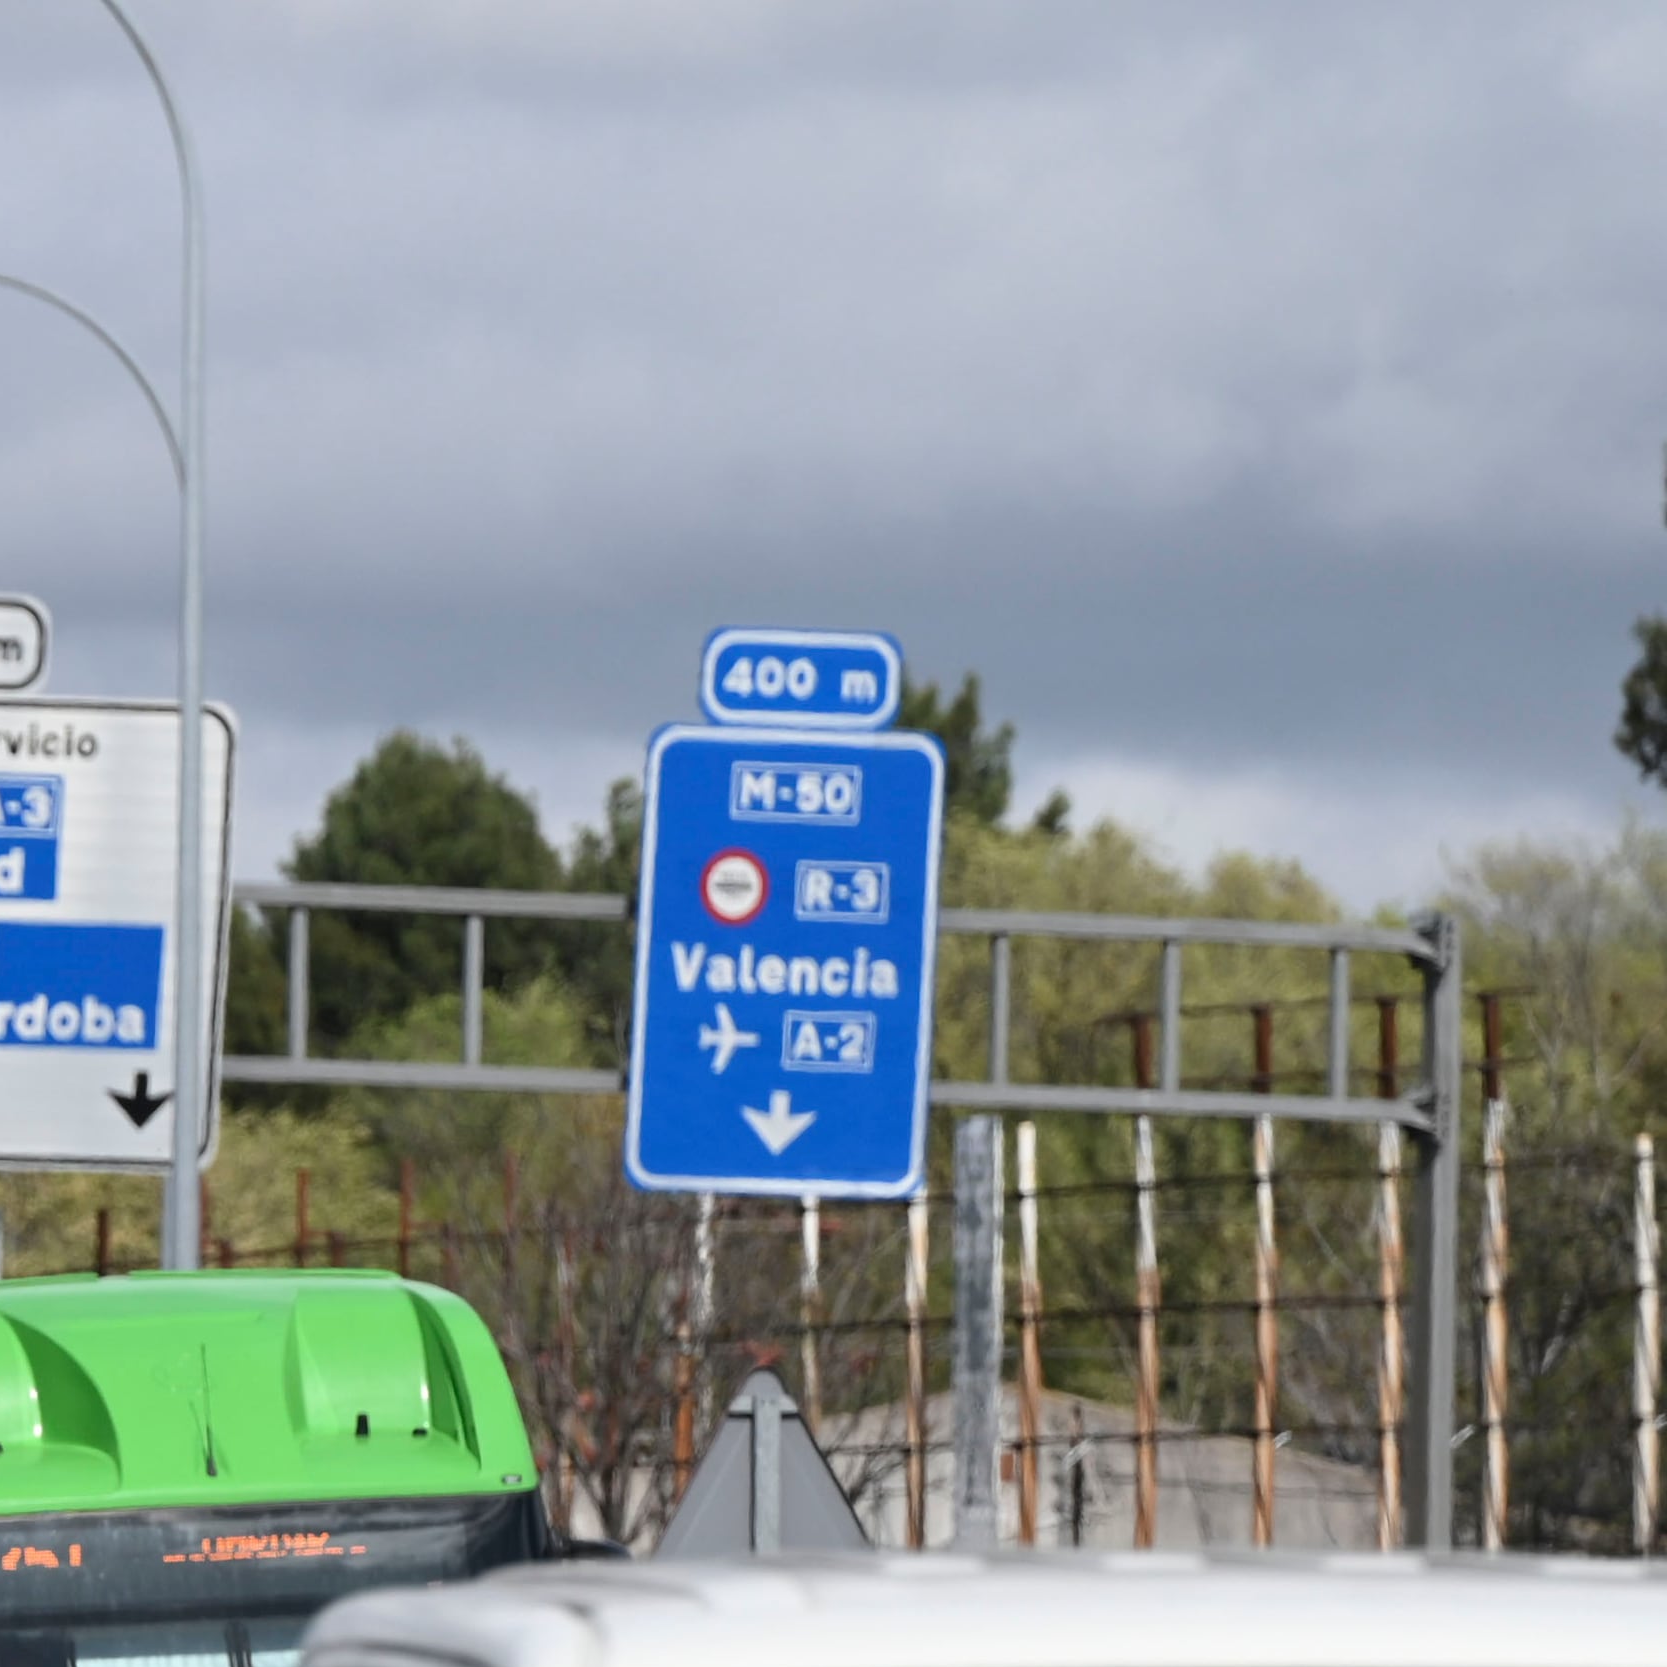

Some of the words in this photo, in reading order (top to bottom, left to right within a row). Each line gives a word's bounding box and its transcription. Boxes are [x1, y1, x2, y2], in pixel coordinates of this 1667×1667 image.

[722, 656, 818, 700] 400
[840, 668, 878, 703] m
[739, 770, 855, 813] M-50
[804, 869, 880, 913] R-3
[670, 940, 900, 999] Valencia
[791, 1021, 868, 1062] A-2
